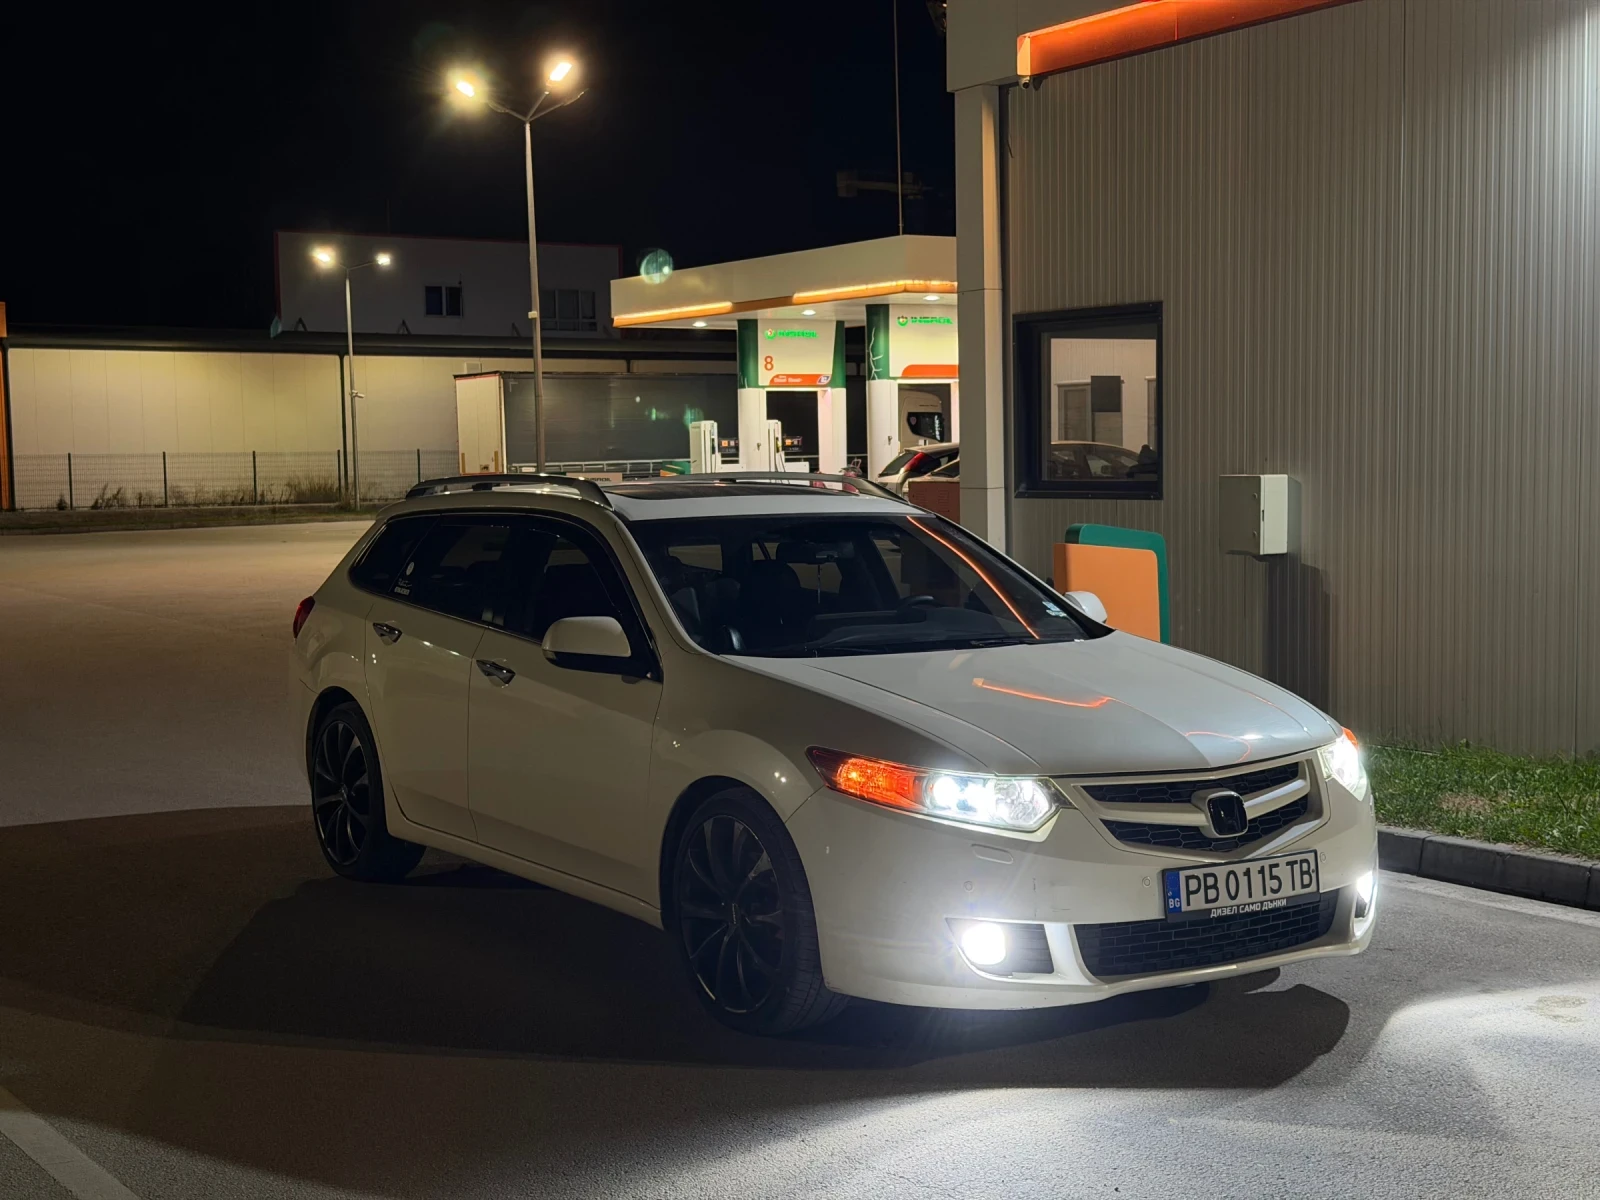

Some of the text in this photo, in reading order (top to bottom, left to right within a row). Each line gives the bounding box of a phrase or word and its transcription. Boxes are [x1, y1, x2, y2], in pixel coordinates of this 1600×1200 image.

[764, 355, 774, 371] 8
[1169, 898, 1181, 909] BG
[1210, 898, 1287, 918] ДИЗЕЛ САМО ДЪНКИ
